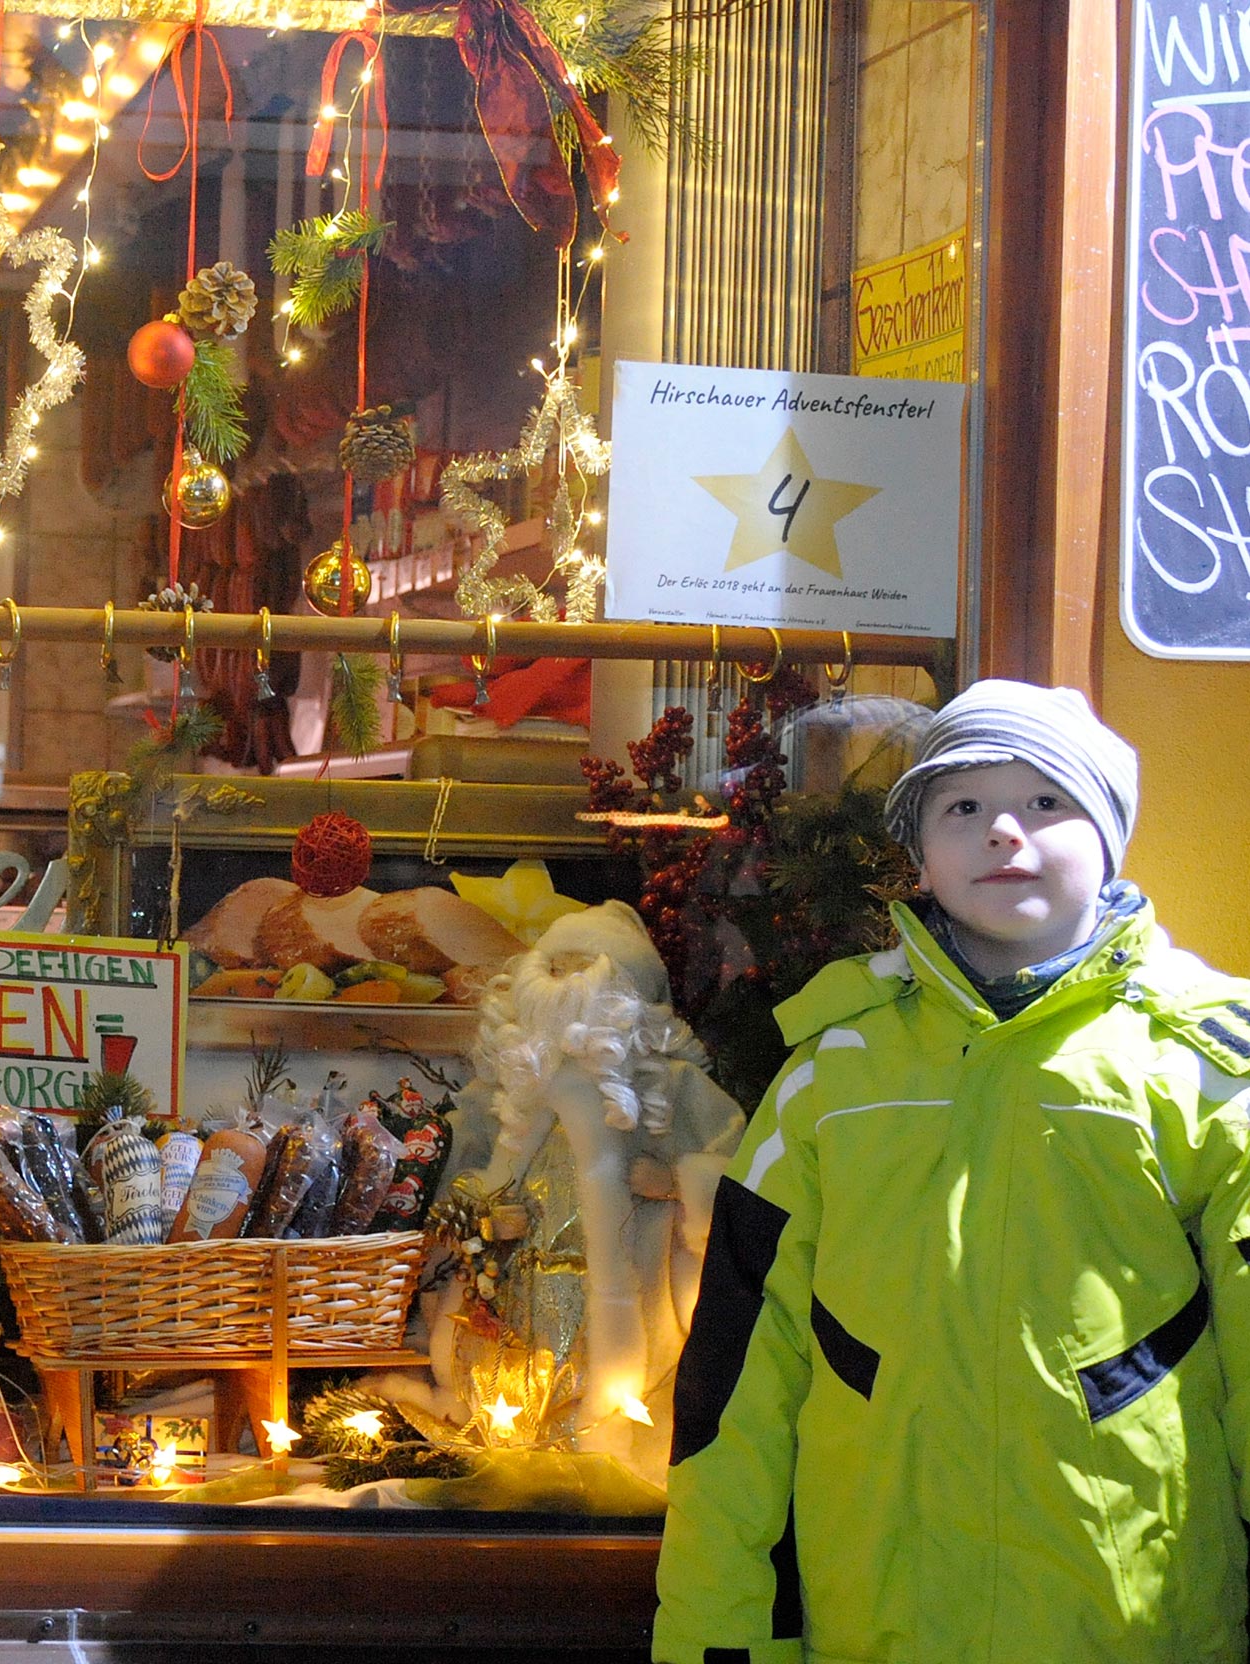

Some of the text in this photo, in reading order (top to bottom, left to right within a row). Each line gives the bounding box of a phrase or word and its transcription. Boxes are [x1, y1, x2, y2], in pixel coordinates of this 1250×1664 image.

[650, 380, 934, 420] Hirschauer Adventsfensterl
[768, 473, 810, 543] 4
[657, 574, 908, 601] Der Erlös 2018 geht an das Frauenhaus Weiden
